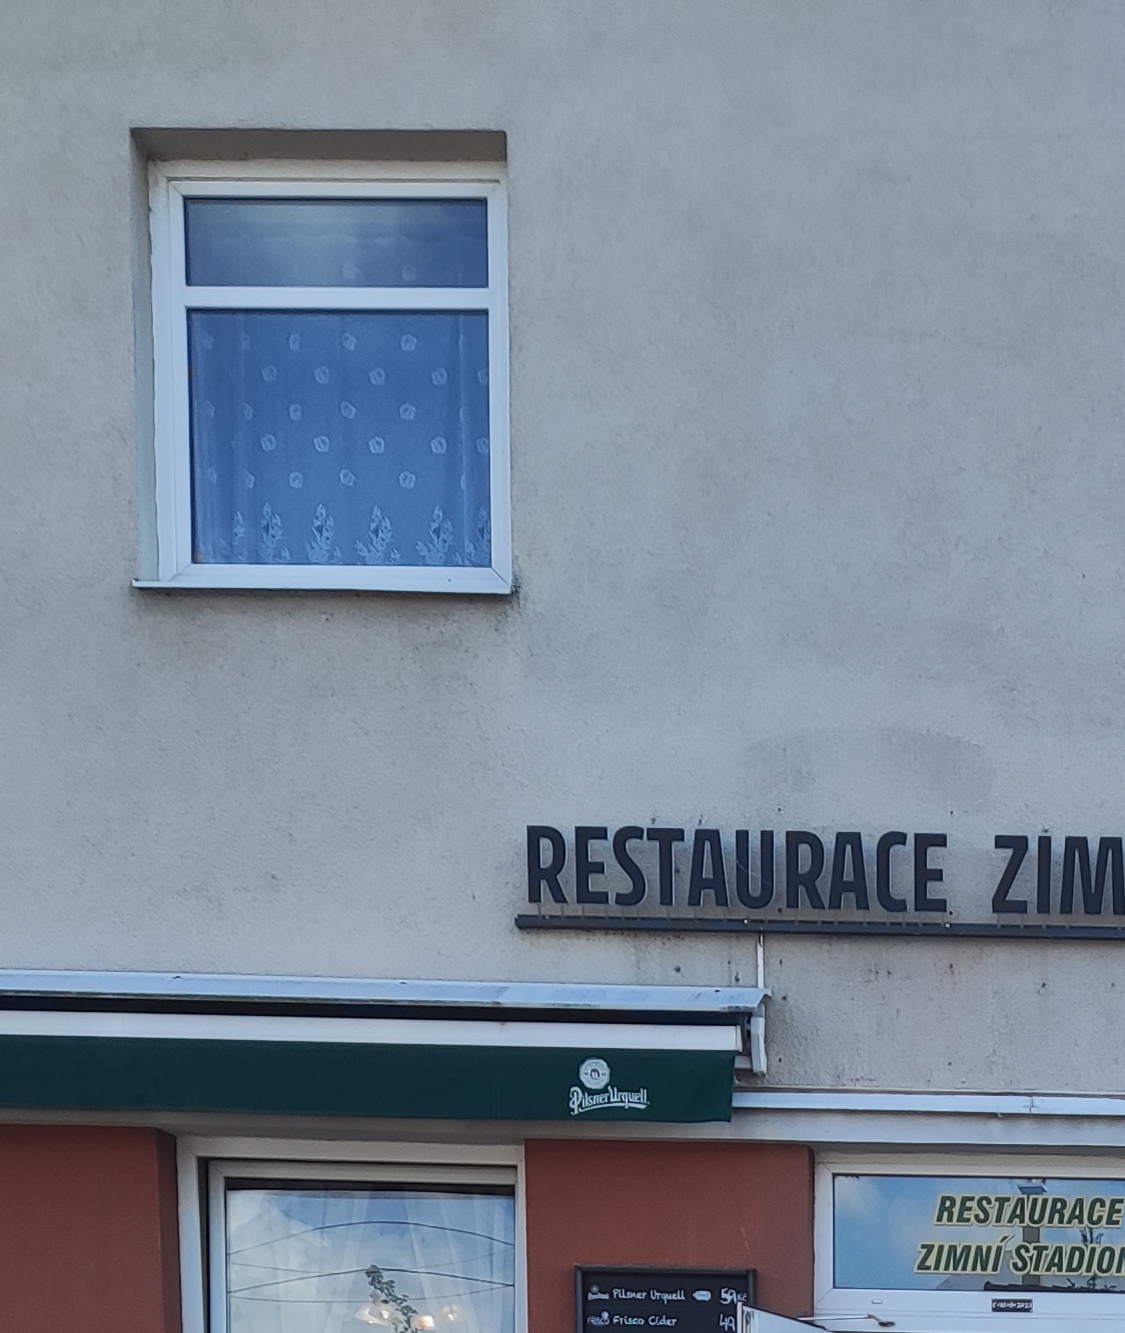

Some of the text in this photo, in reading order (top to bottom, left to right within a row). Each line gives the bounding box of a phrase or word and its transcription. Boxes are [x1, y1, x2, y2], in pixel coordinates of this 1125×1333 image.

[526, 825, 948, 912] RESTAURACE
[569, 1086, 610, 1115] Pilsner
[935, 1195, 1125, 1227] RESTAURACE
[916, 1234, 1012, 1273] ZIMNÍ
[612, 1288, 647, 1299] Pilsner
[650, 1289, 685, 1305] Urquell
[613, 1315, 644, 1325] Frisco
